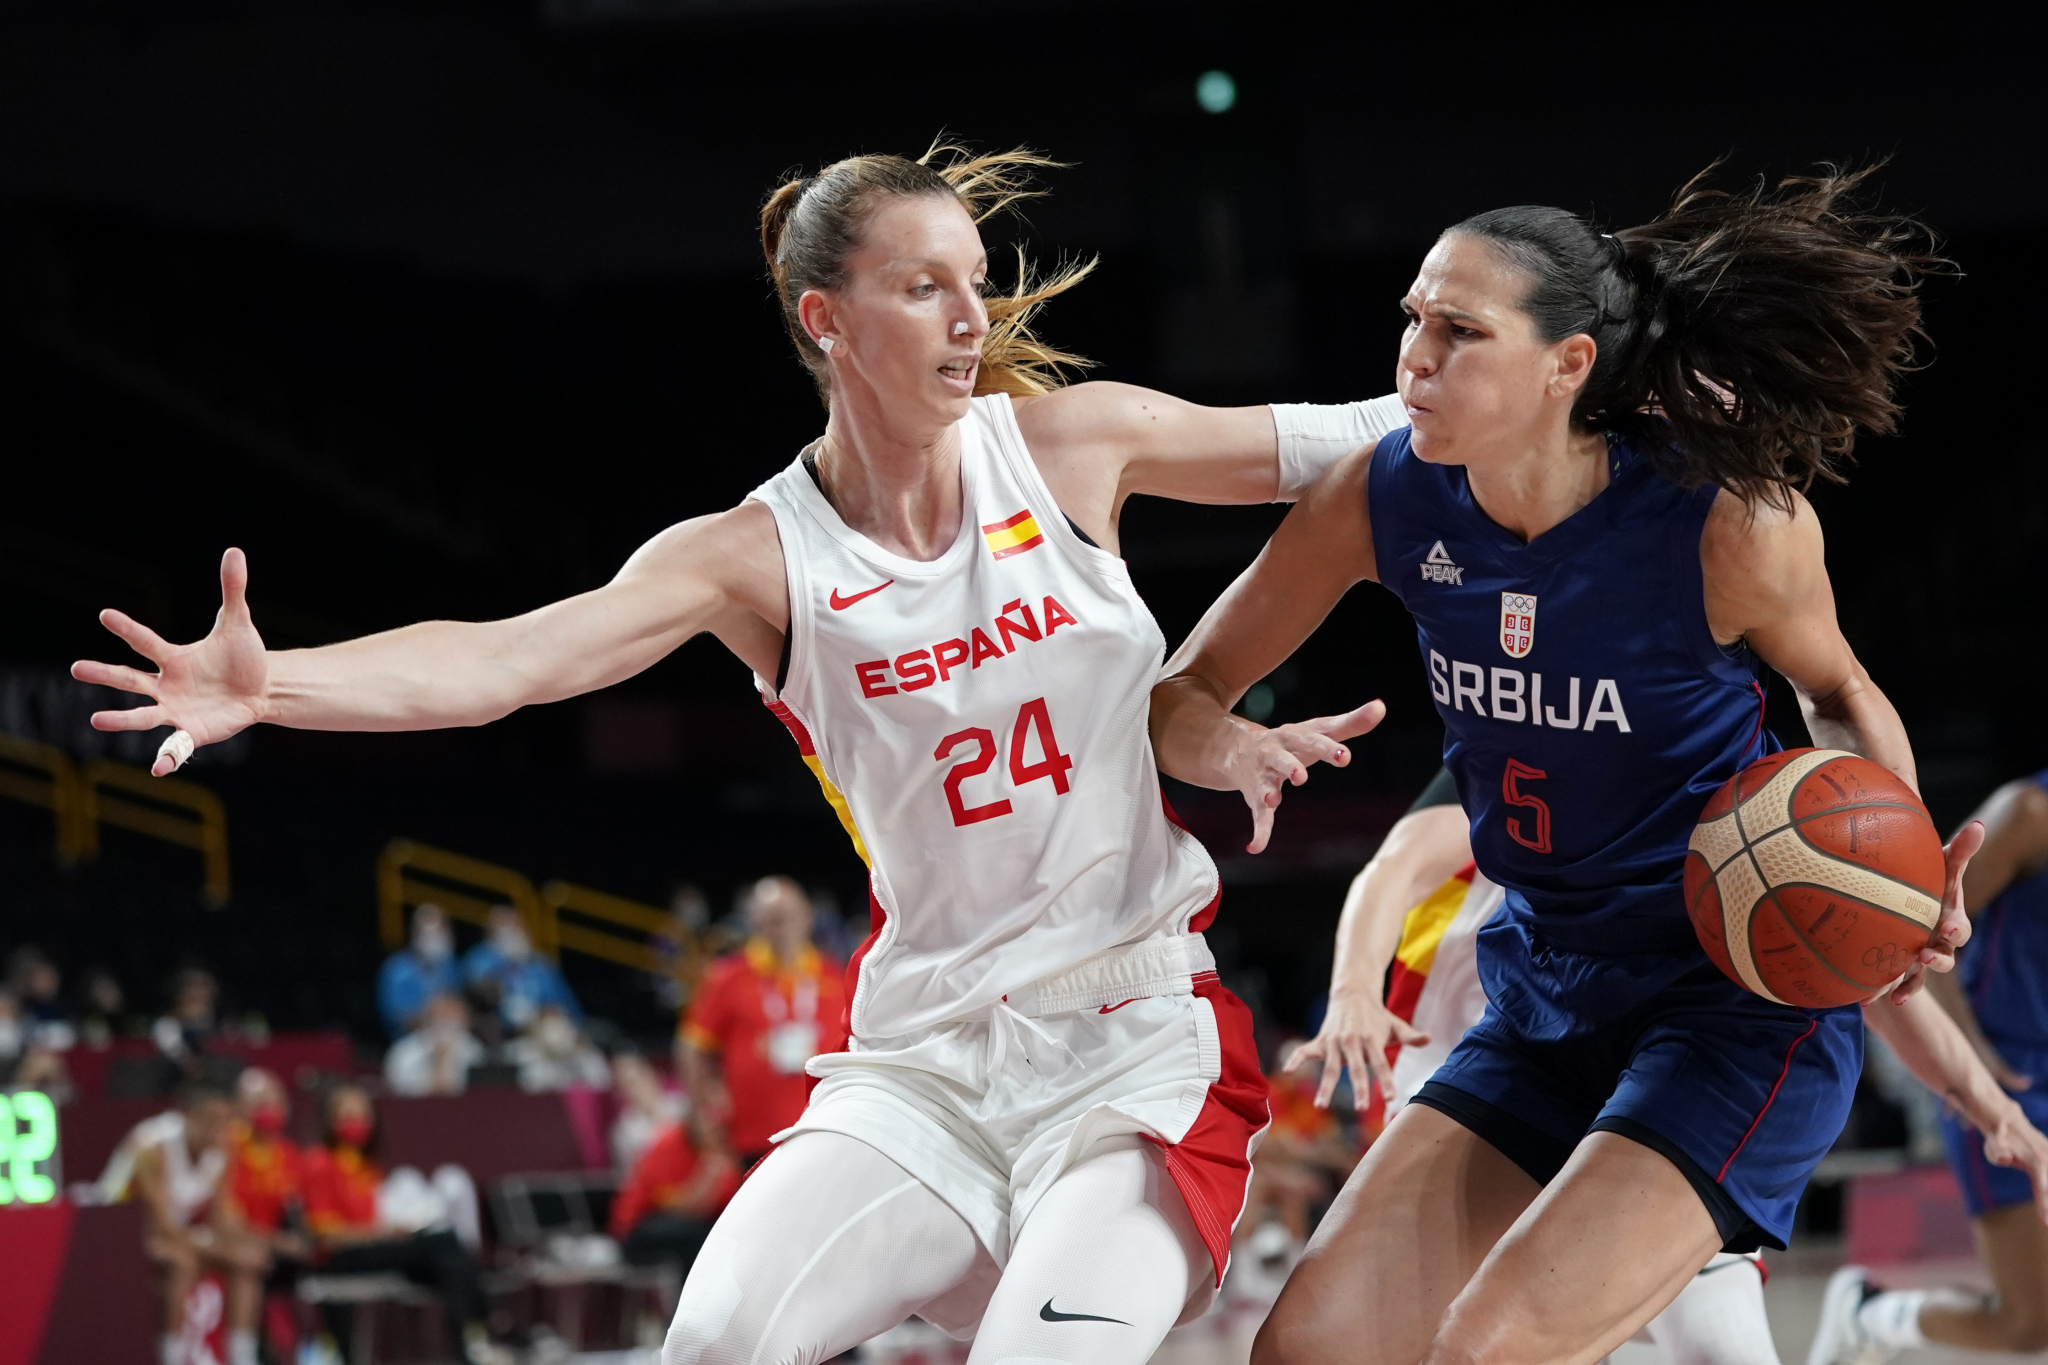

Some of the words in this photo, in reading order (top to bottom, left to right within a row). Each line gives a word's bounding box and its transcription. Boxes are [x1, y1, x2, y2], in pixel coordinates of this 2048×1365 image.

[1420, 563, 1464, 586] PEAK
[855, 595, 1078, 699] ESPAÑA
[1430, 648, 1632, 733] SRBIJA
[934, 697, 1073, 827] 24
[1502, 757, 1552, 854] 5
